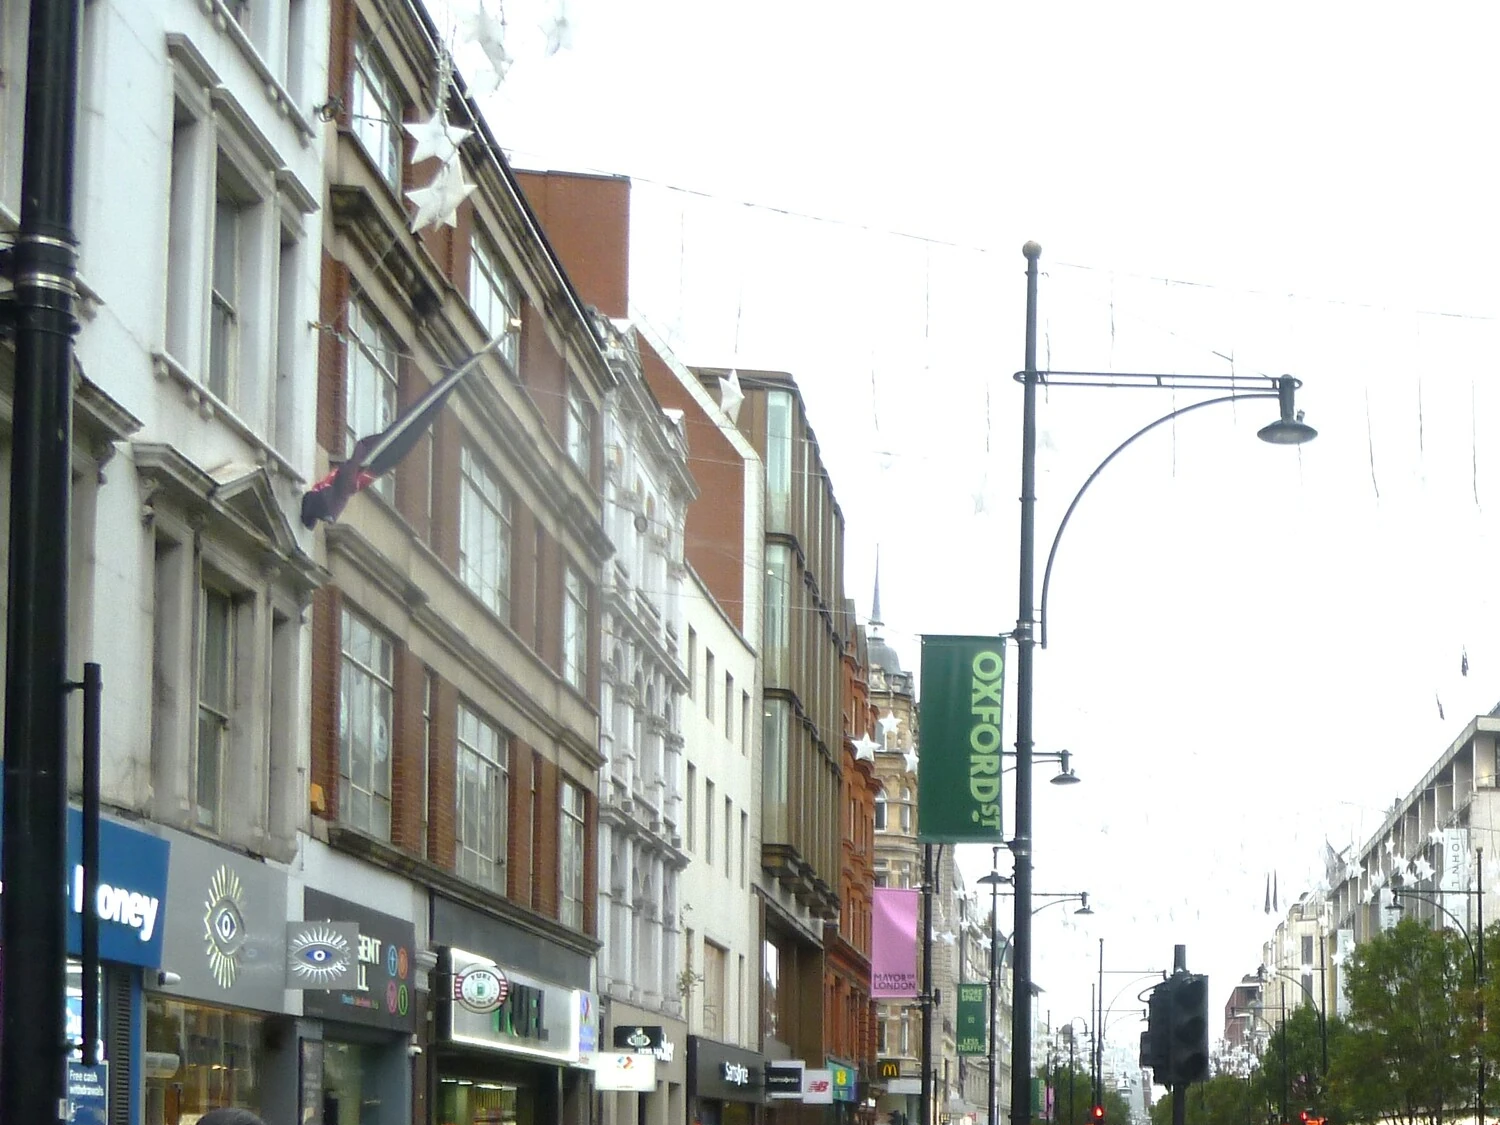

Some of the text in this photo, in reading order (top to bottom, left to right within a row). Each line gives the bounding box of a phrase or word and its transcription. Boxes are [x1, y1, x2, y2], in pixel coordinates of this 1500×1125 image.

[970, 651, 1003, 803] OXFORD
[1451, 836, 1460, 876] JOHN
[873, 982, 916, 990] LONDON
[70, 1069, 97, 1082] Free cash
